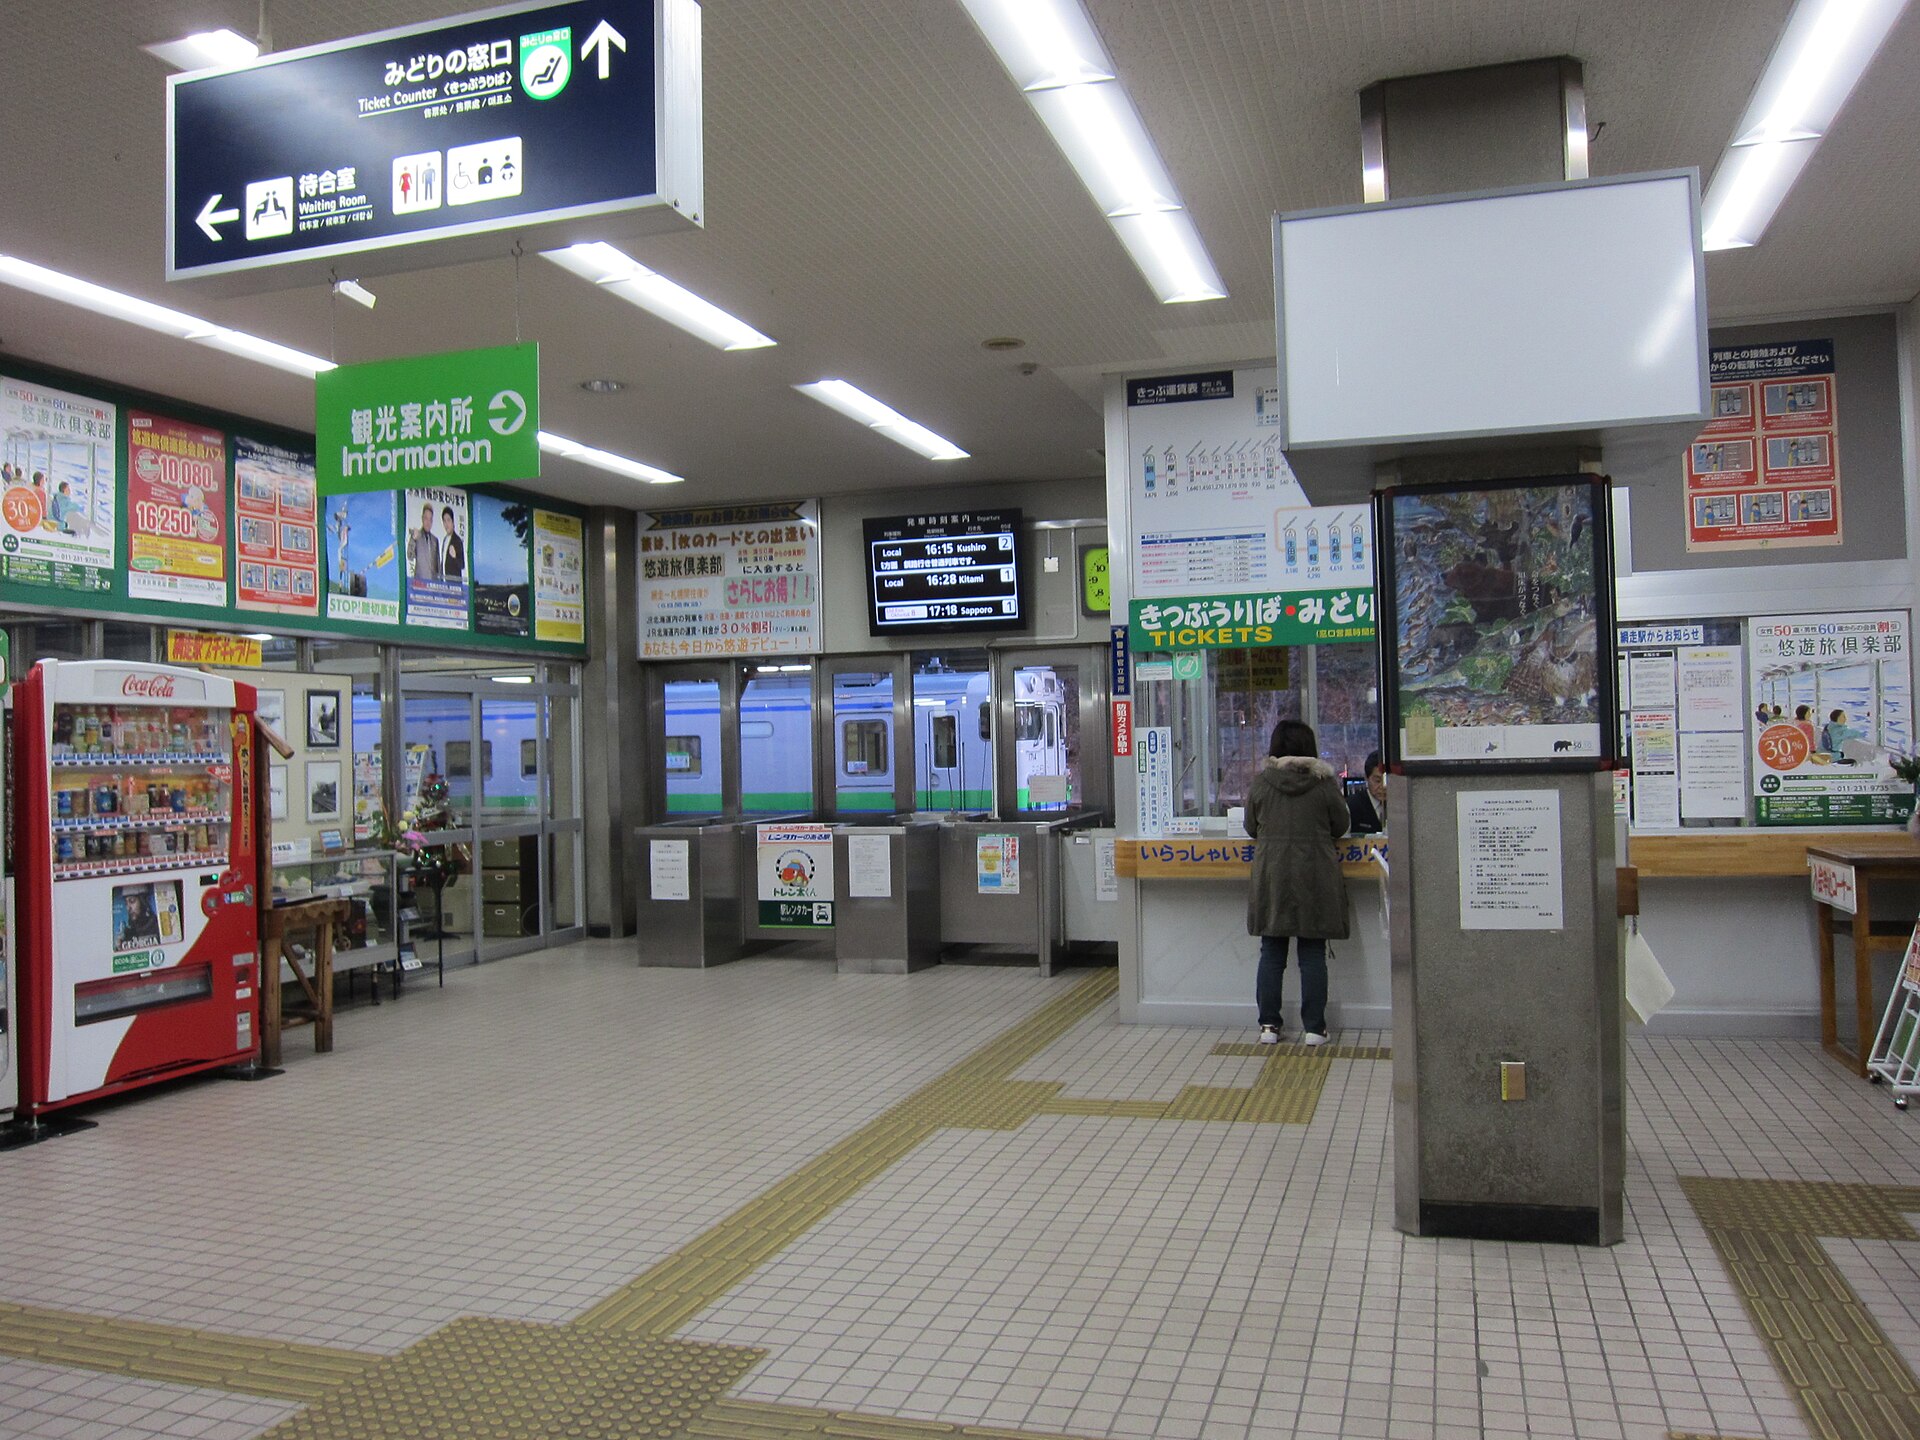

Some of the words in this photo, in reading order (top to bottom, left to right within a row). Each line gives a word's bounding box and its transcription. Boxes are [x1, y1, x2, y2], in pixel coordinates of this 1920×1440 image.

[384, 39, 512, 86] みどりの窓口
[358, 91, 391, 112] Ticket
[393, 86, 438, 106] Counter
[298, 167, 356, 198] 待合室
[299, 199, 337, 215] Waiting
[339, 194, 367, 209] Room
[351, 395, 474, 445] 観光案内所
[342, 436, 493, 477] Information
[882, 547, 902, 558] Local
[924, 543, 954, 556] 16:15
[956, 543, 987, 554] Kushiro
[644, 555, 723, 579] 悠遊旅倶楽部
[742, 562, 805, 575] に入会すると
[884, 577, 904, 588] Local
[926, 573, 957, 587] 16:28
[958, 574, 984, 584] Kitami
[1091, 576, 1099, 584] 9
[1097, 588, 1104, 596] 8
[928, 604, 958, 617] 17:18
[960, 606, 993, 617] Sapporo
[1148, 626, 1274, 647] TICKETS
[1619, 627, 1700, 644] 網走駅からお知らせ
[1778, 634, 1902, 657] 悠遊旅倶楽部
[1116, 702, 1128, 755] 防犯カメラ作動中
[767, 833, 831, 841] レンタカーのある駅
[1141, 844, 1255, 862] いらっしゃいま
[773, 887, 818, 898] トレン太くん
[780, 903, 813, 916] 駅レンタカー
[121, 935, 160, 950] GEORGIA
